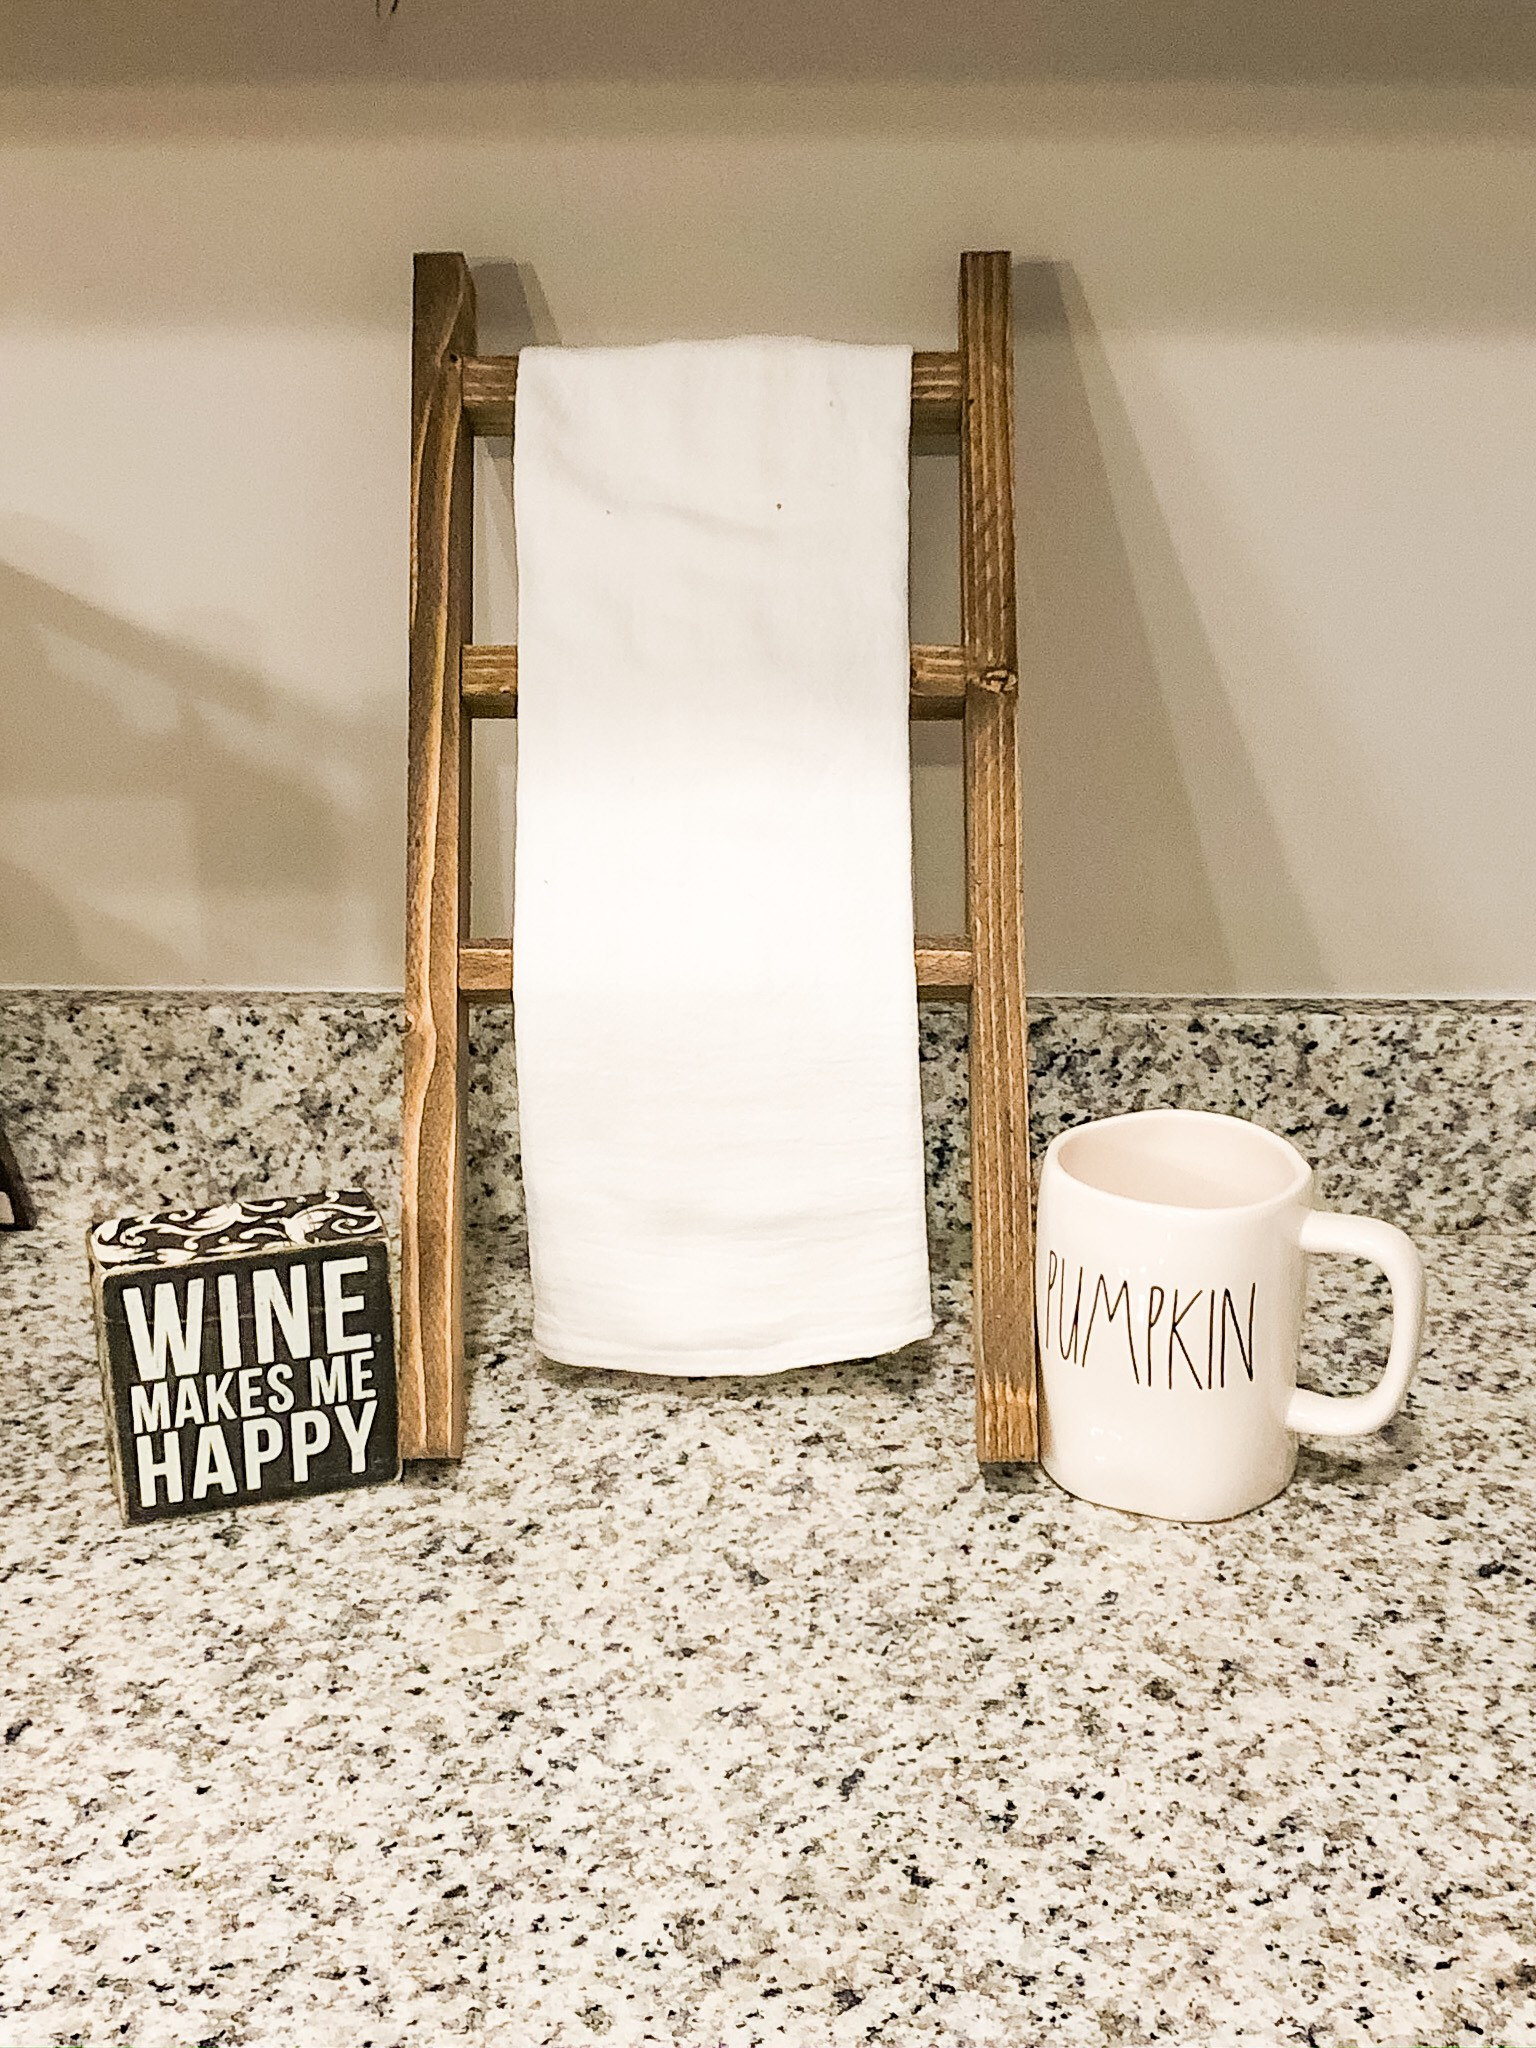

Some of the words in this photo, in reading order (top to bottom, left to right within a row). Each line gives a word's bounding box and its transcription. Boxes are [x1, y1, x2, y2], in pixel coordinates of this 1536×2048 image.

[122, 1255, 372, 1382] WINE
[1045, 1249, 1256, 1390] PUMPKIN
[130, 1363, 295, 1435] MAKES
[309, 1350, 377, 1407] ME
[136, 1399, 378, 1508] HAPPY
